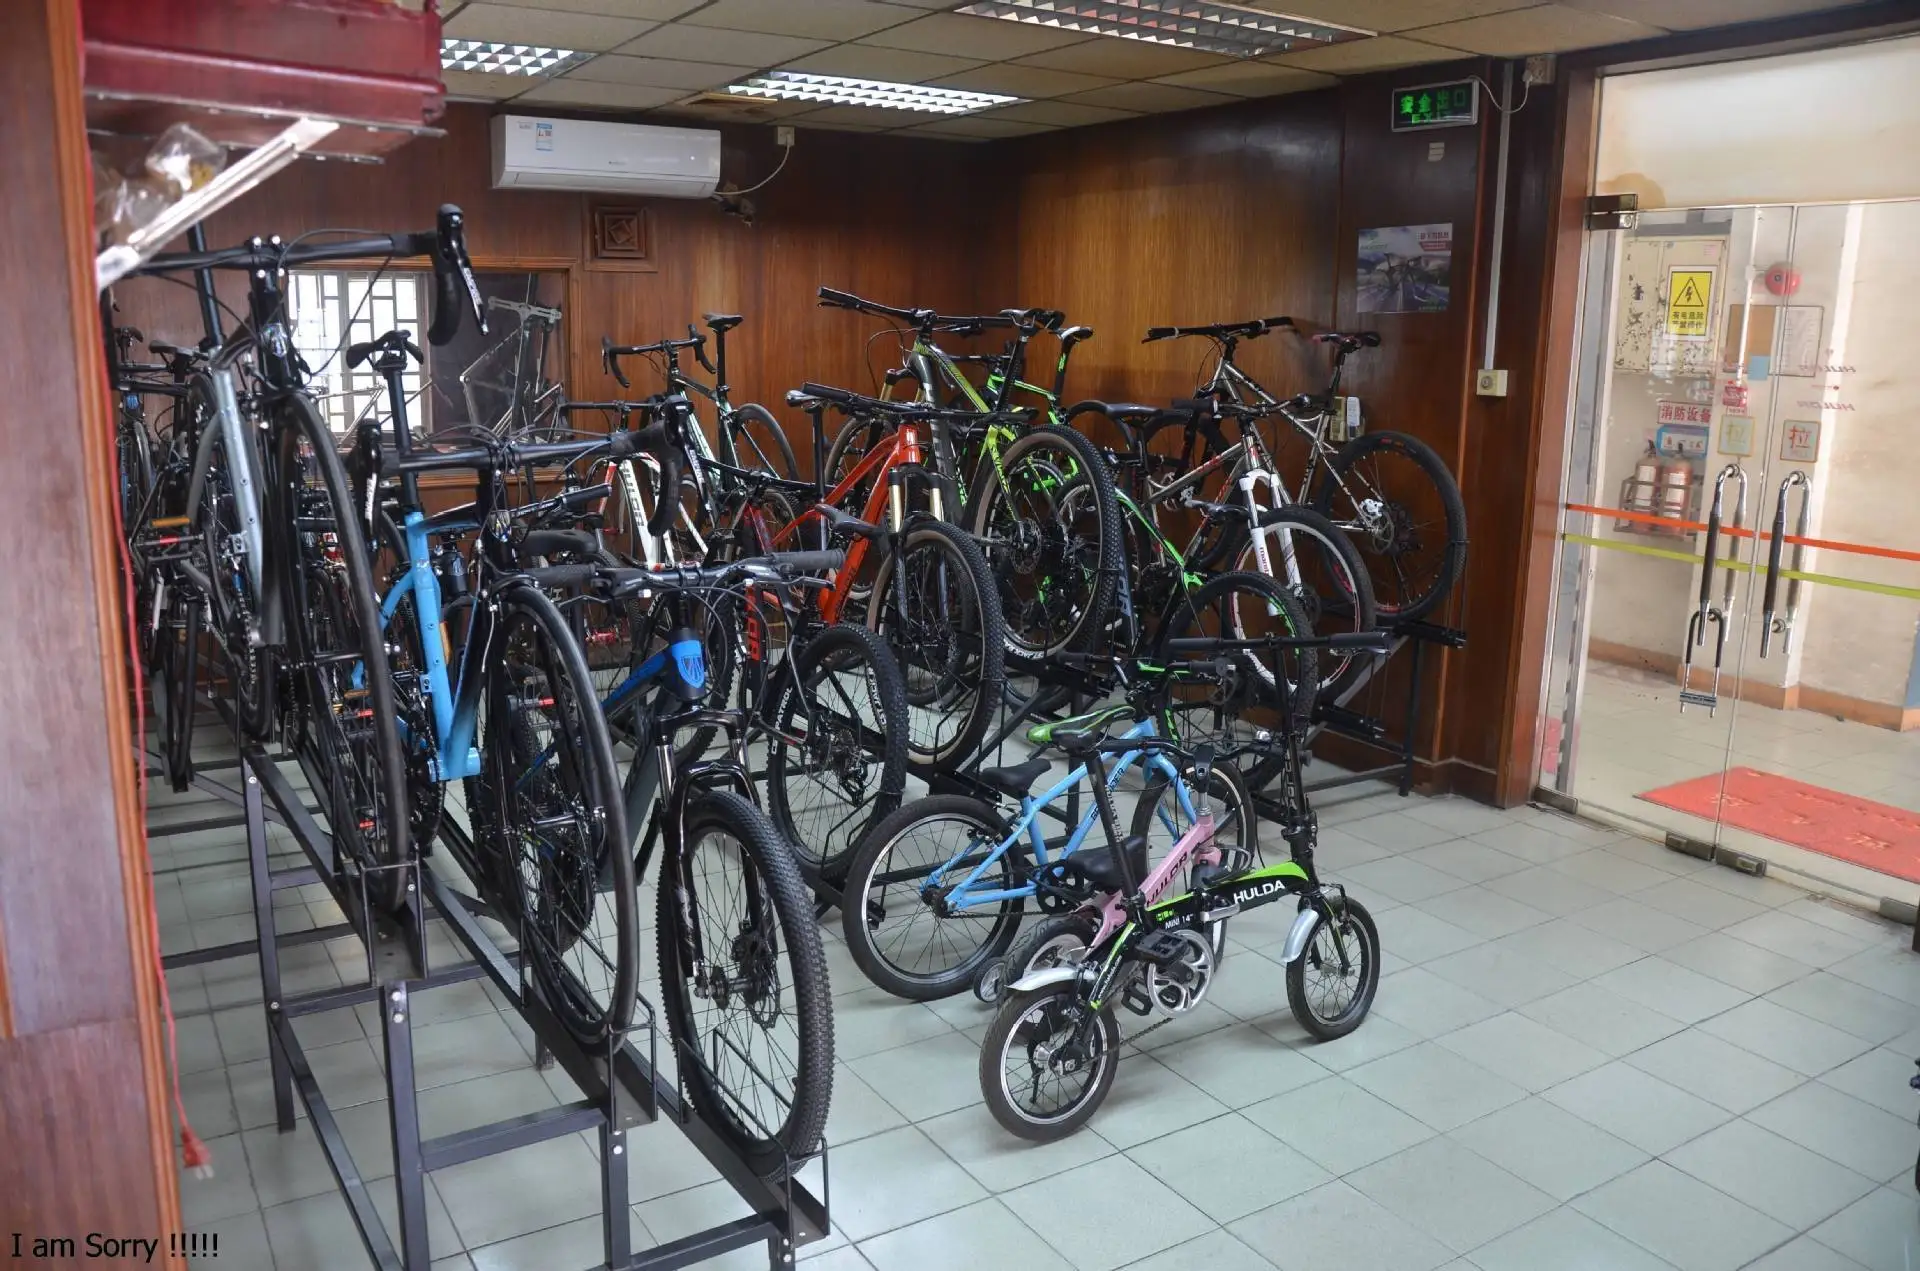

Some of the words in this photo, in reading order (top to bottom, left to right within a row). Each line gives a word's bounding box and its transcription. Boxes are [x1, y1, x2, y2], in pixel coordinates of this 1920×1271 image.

[1660, 405, 1712, 423] 消防设备
[774, 686, 793, 731] PATROL
[1233, 879, 1286, 904] HULDA
[1165, 917, 1180, 930] MINI
